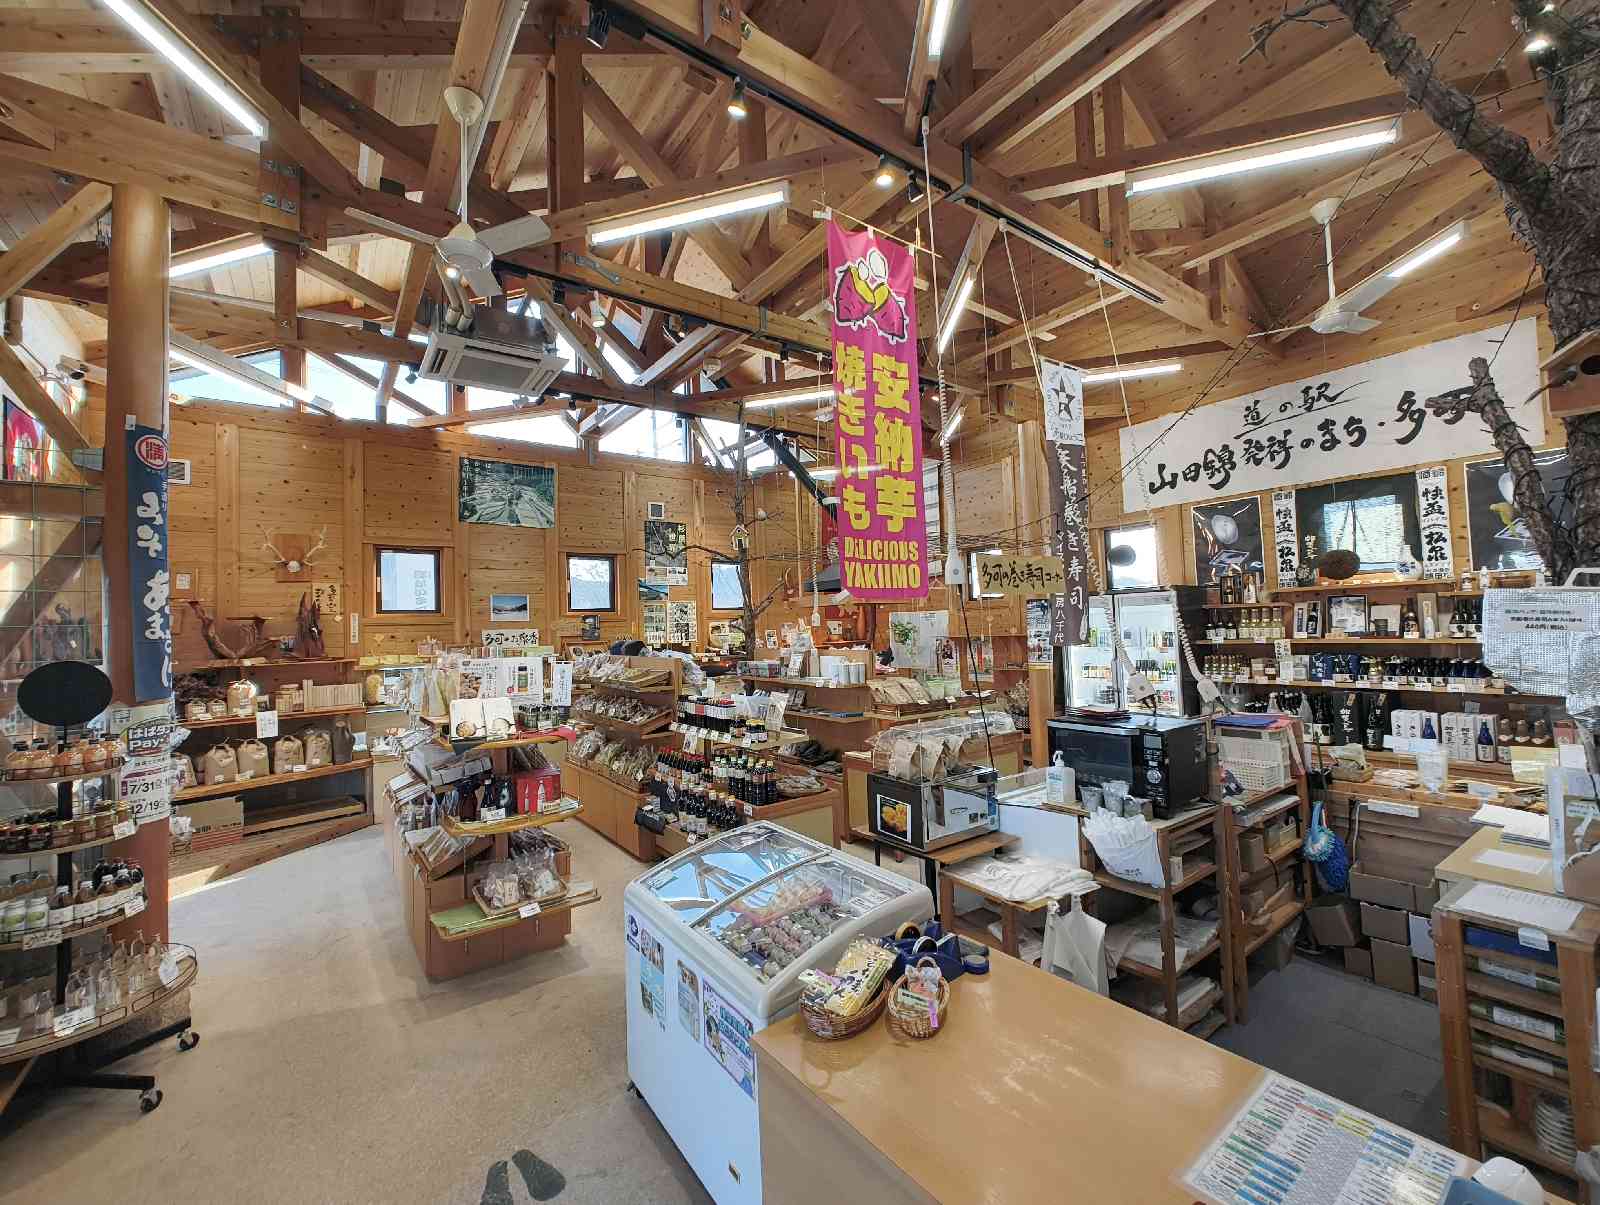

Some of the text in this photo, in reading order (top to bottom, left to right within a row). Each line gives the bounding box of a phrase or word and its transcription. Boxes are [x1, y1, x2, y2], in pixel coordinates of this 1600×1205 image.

[1242, 380, 1363, 428] 道の駅
[836, 340, 870, 530] 焼きいも
[873, 352, 917, 533] 安納芋
[844, 560, 921, 589] YAKIIMO
[129, 781, 154, 795] 7/31
